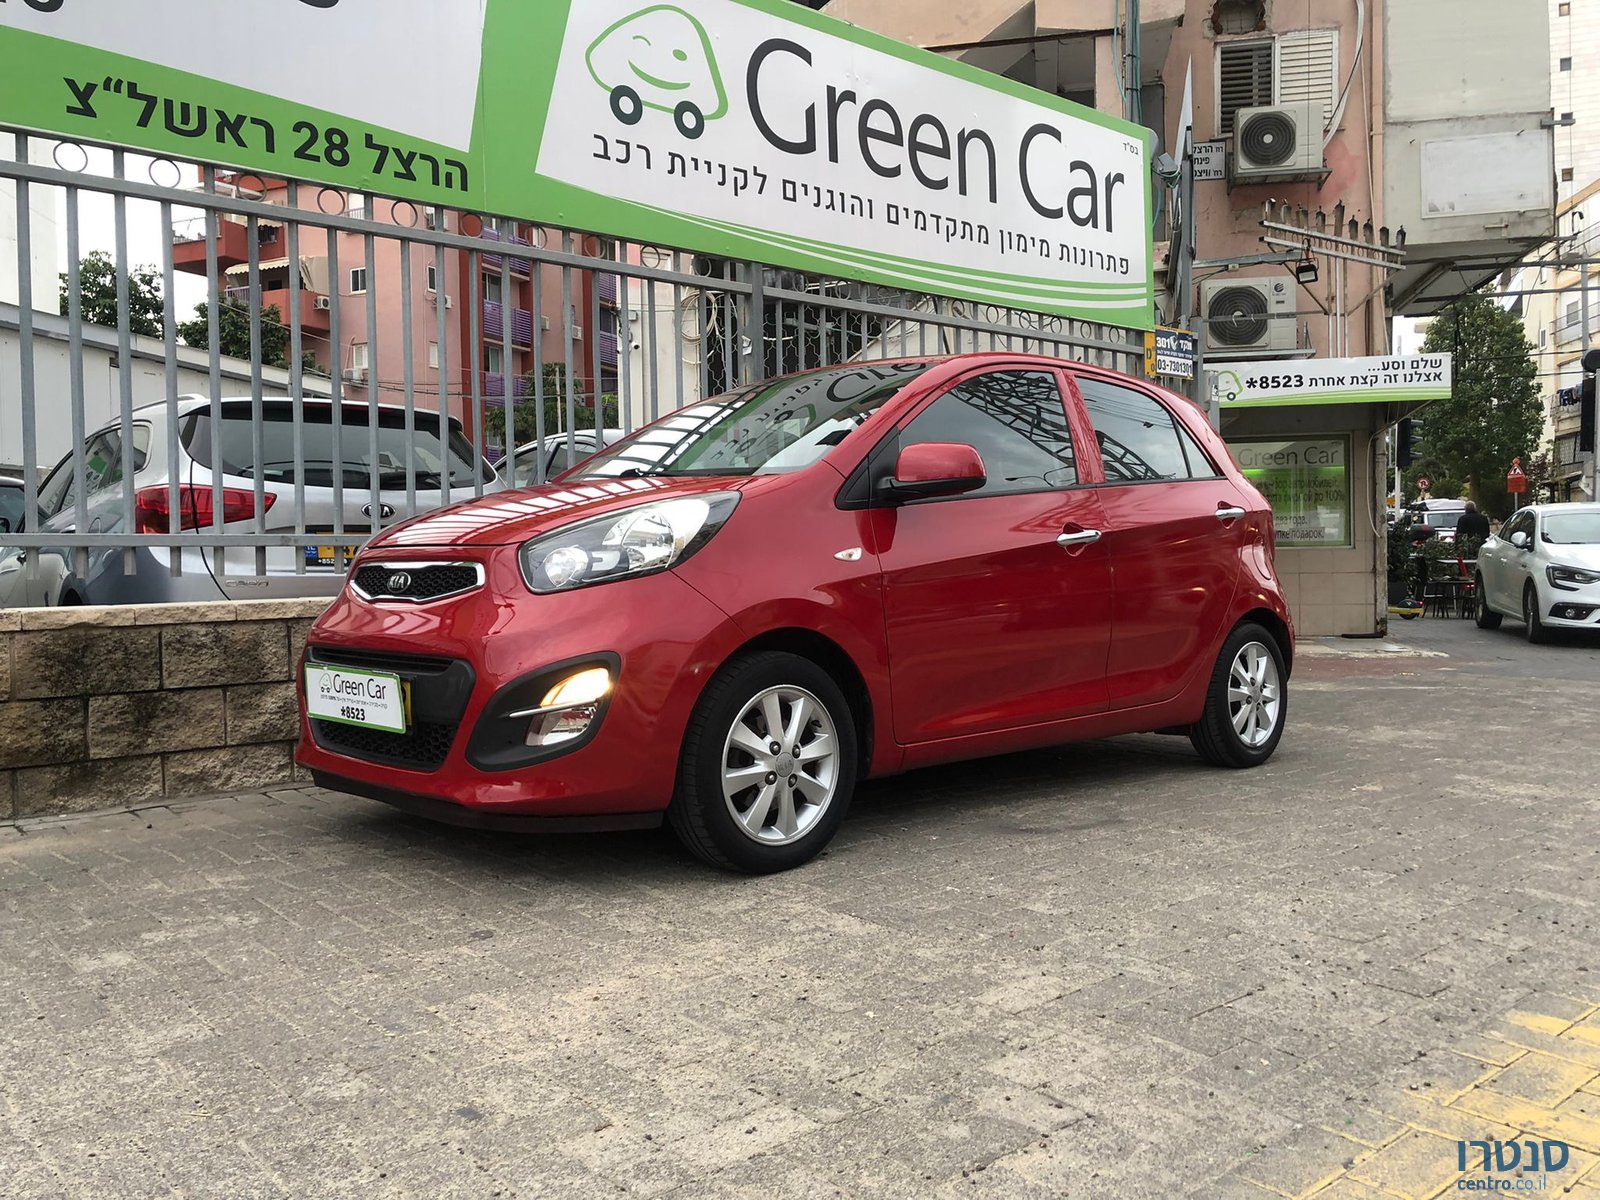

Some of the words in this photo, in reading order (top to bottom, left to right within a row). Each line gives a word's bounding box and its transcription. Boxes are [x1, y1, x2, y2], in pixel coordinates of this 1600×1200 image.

[292, 121, 350, 167] 28
[746, 38, 997, 204] Green
[1018, 123, 1125, 233] Car
[364, 132, 469, 192] הרצל
[592, 133, 652, 170] רכב
[667, 152, 768, 197] לקניית
[782, 179, 874, 220] והוגנים
[886, 204, 989, 245] מתקדמים
[999, 229, 1050, 258] מימון
[1058, 244, 1129, 275] פתרונות
[1156, 336, 1170, 349] 301
[1403, 371, 1443, 383] אצלנו
[1410, 357, 1442, 370] שלם
[1308, 376, 1346, 388] אחרת
[1349, 374, 1379, 388] קצת
[1383, 373, 1399, 384] זה
[1238, 447, 1298, 467] Green
[1303, 446, 1339, 465] Car
[388, 574, 405, 589] KIA
[332, 673, 365, 697] Green
[366, 678, 387, 700] Car
